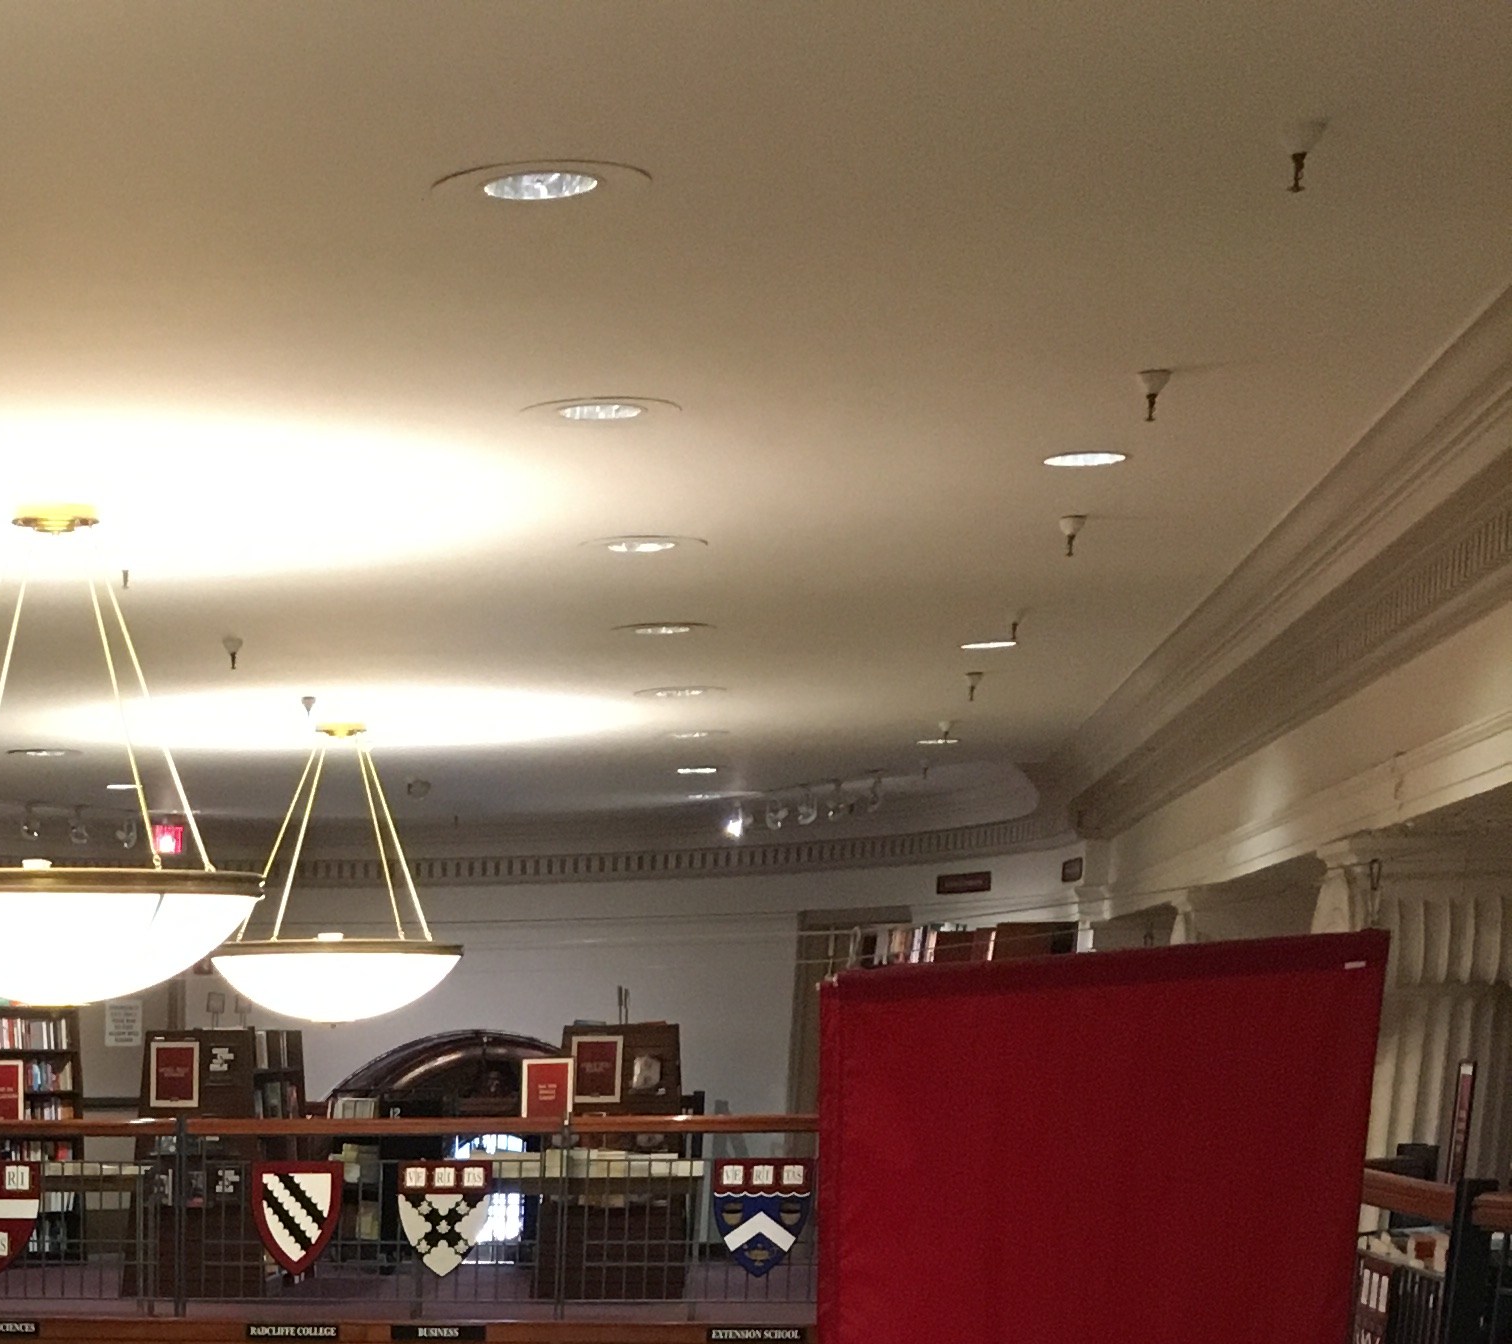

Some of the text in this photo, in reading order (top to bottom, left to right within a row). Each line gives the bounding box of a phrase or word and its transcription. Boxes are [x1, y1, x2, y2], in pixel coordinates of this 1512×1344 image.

[7, 1168, 26, 1186] RI
[250, 1326, 336, 1338] RADCLIFFE COLLEGE
[417, 1327, 460, 1338] BUSINESS
[711, 1329, 801, 1341] EXTENSION SCHOOL
